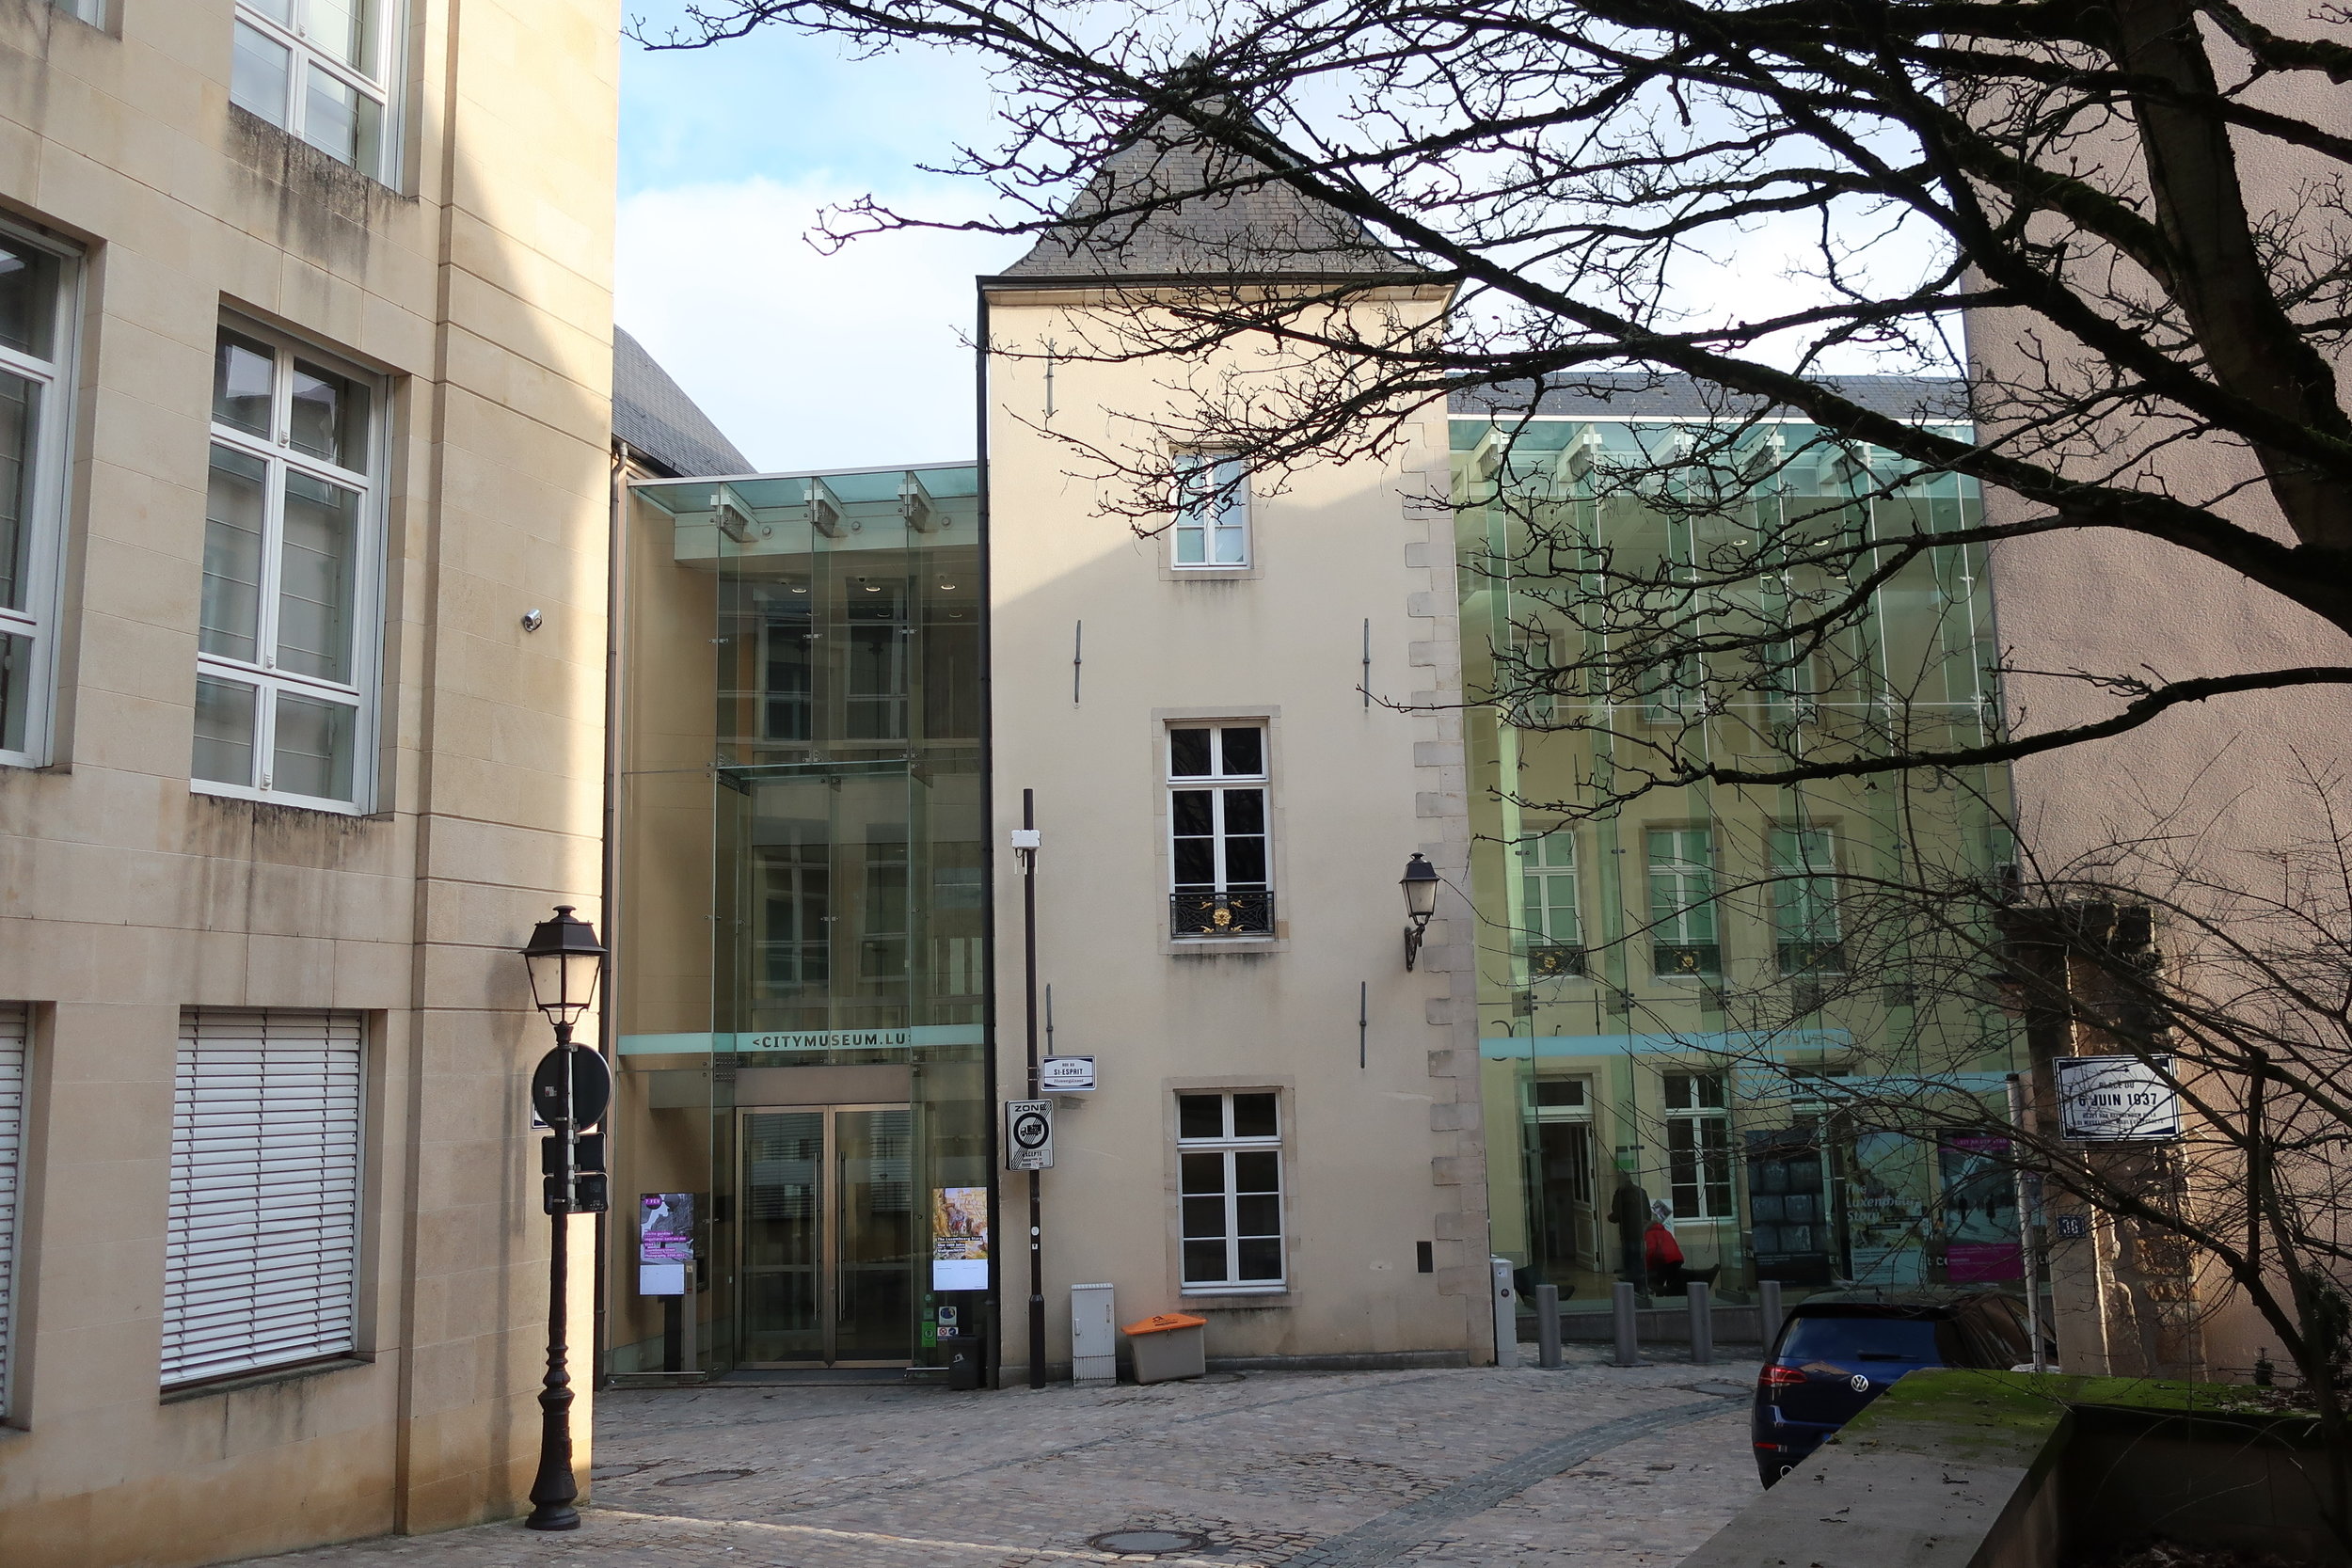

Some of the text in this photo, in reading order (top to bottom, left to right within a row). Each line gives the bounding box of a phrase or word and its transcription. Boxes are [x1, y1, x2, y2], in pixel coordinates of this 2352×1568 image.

[2078, 1093, 2158, 1107] 6 JUIN 1937
[1844, 1183, 1867, 1195] The
[1847, 1210, 1880, 1223] Story
